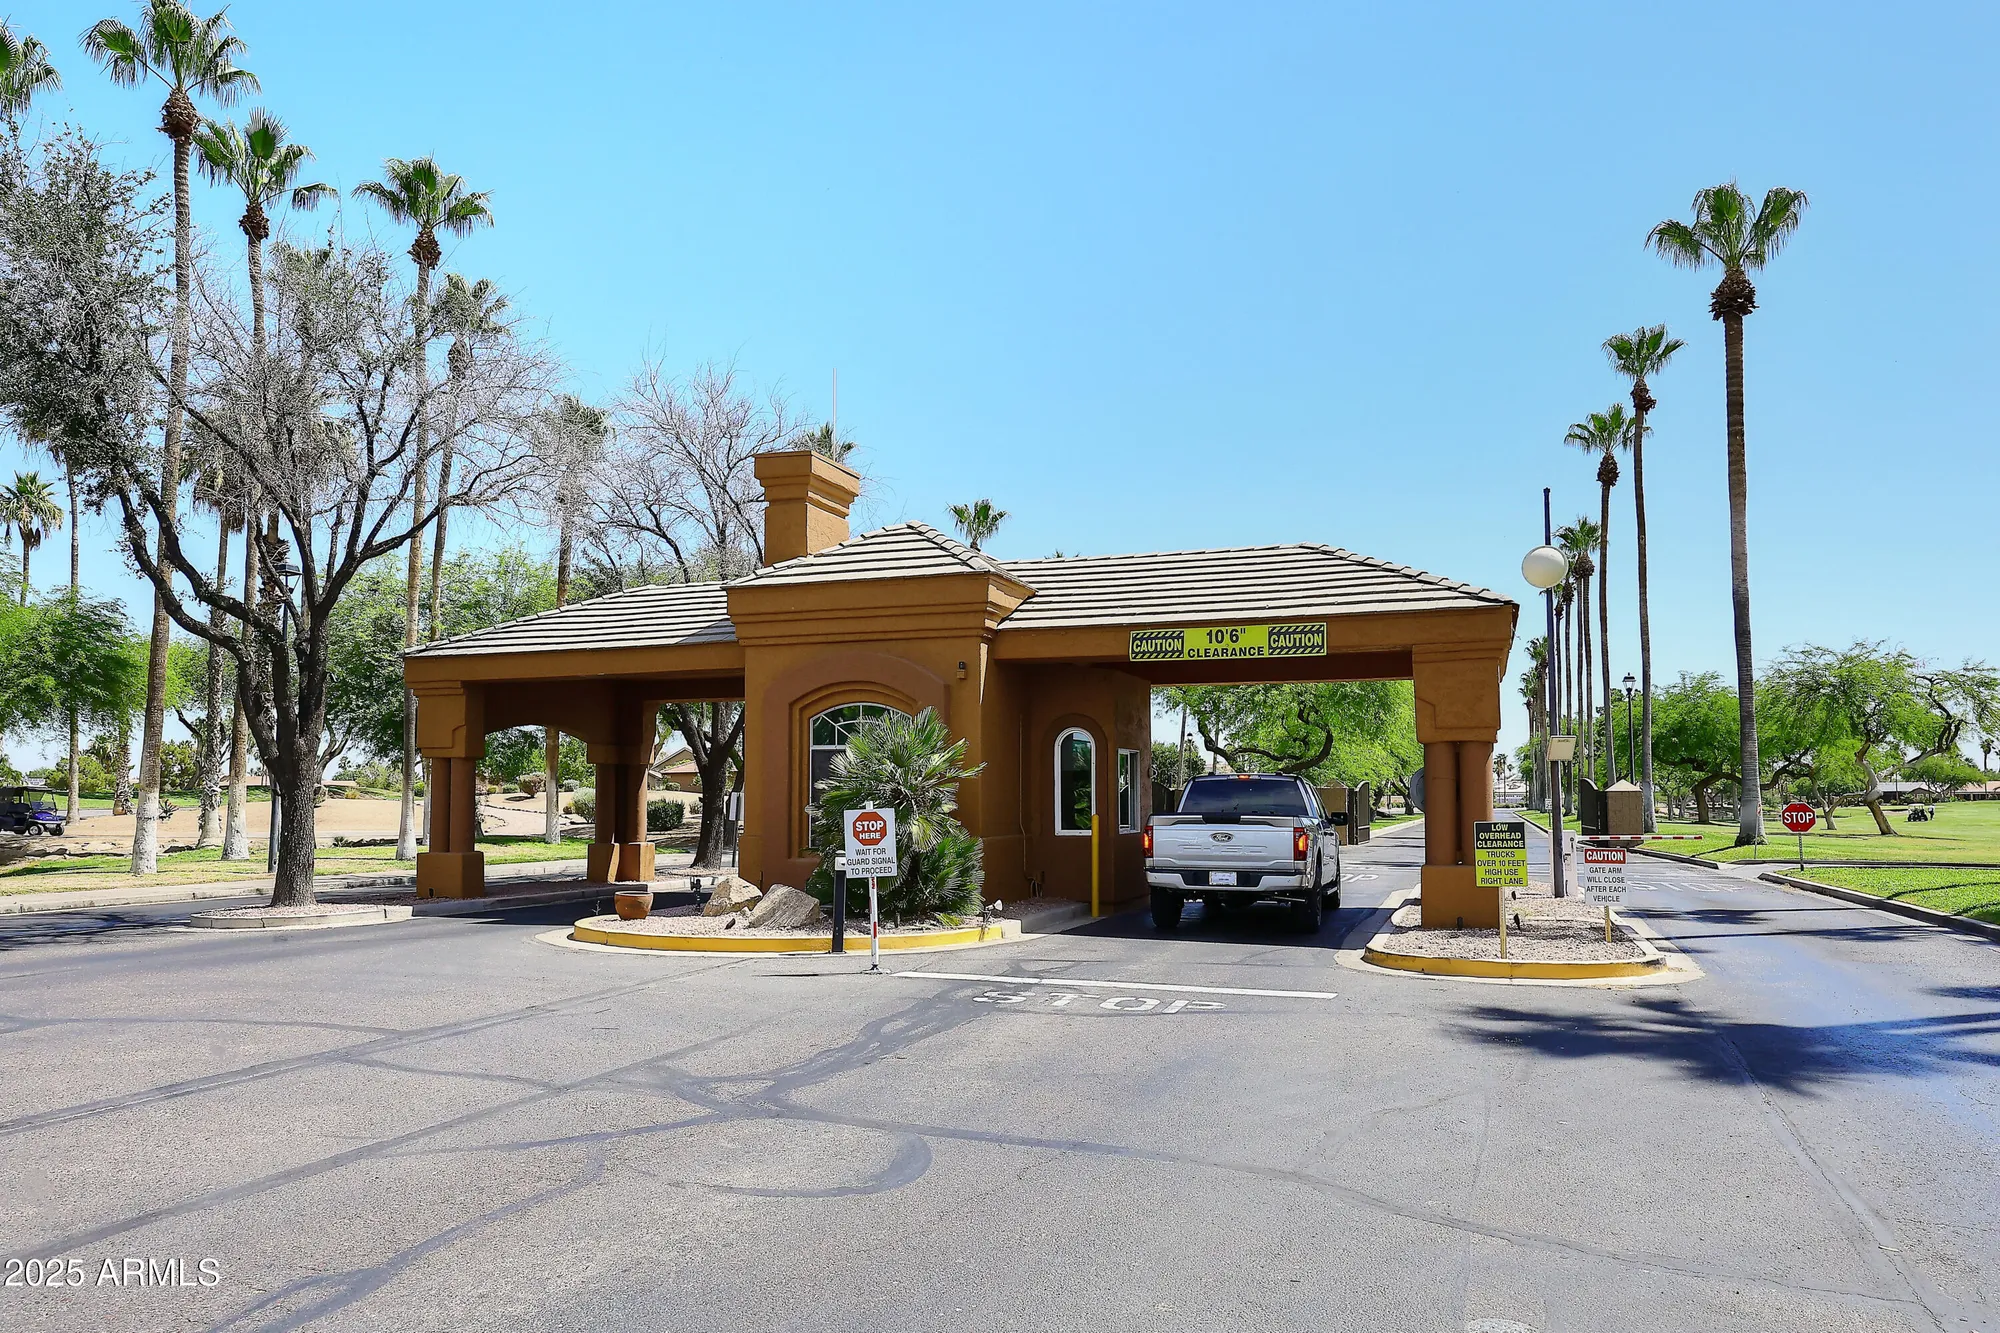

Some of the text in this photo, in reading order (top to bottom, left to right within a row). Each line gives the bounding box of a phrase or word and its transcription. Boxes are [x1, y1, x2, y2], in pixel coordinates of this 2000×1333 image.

[1206, 627, 1247, 645] 10'6"
[1269, 633, 1322, 648] CAUTION
[1133, 638, 1182, 653] CAUTION
[1187, 646, 1265, 659] CLEARANCE
[1784, 812, 1814, 824] STOP
[855, 820, 884, 831] STOP
[859, 832, 882, 840] HERE
[1477, 840, 1524, 848] CLEARANCE
[855, 847, 886, 856] WAIT FOR
[1486, 850, 1516, 858] TRUCKS
[1586, 851, 1624, 861] CAUTION
[846, 857, 895, 866] GUARD SIGNAL
[850, 866, 893, 875] TO PROCEED
[1484, 868, 1519, 876] HIGH USE
[1589, 866, 1623, 874] GATE ARM
[1480, 877, 1524, 885] RIGHT LANE
[1603, 876, 1626, 884] CLOSE
[1586, 885, 1607, 893] AFTER
[1592, 895, 1621, 903] VEHICLE
[972, 990, 1228, 1014] STOP
